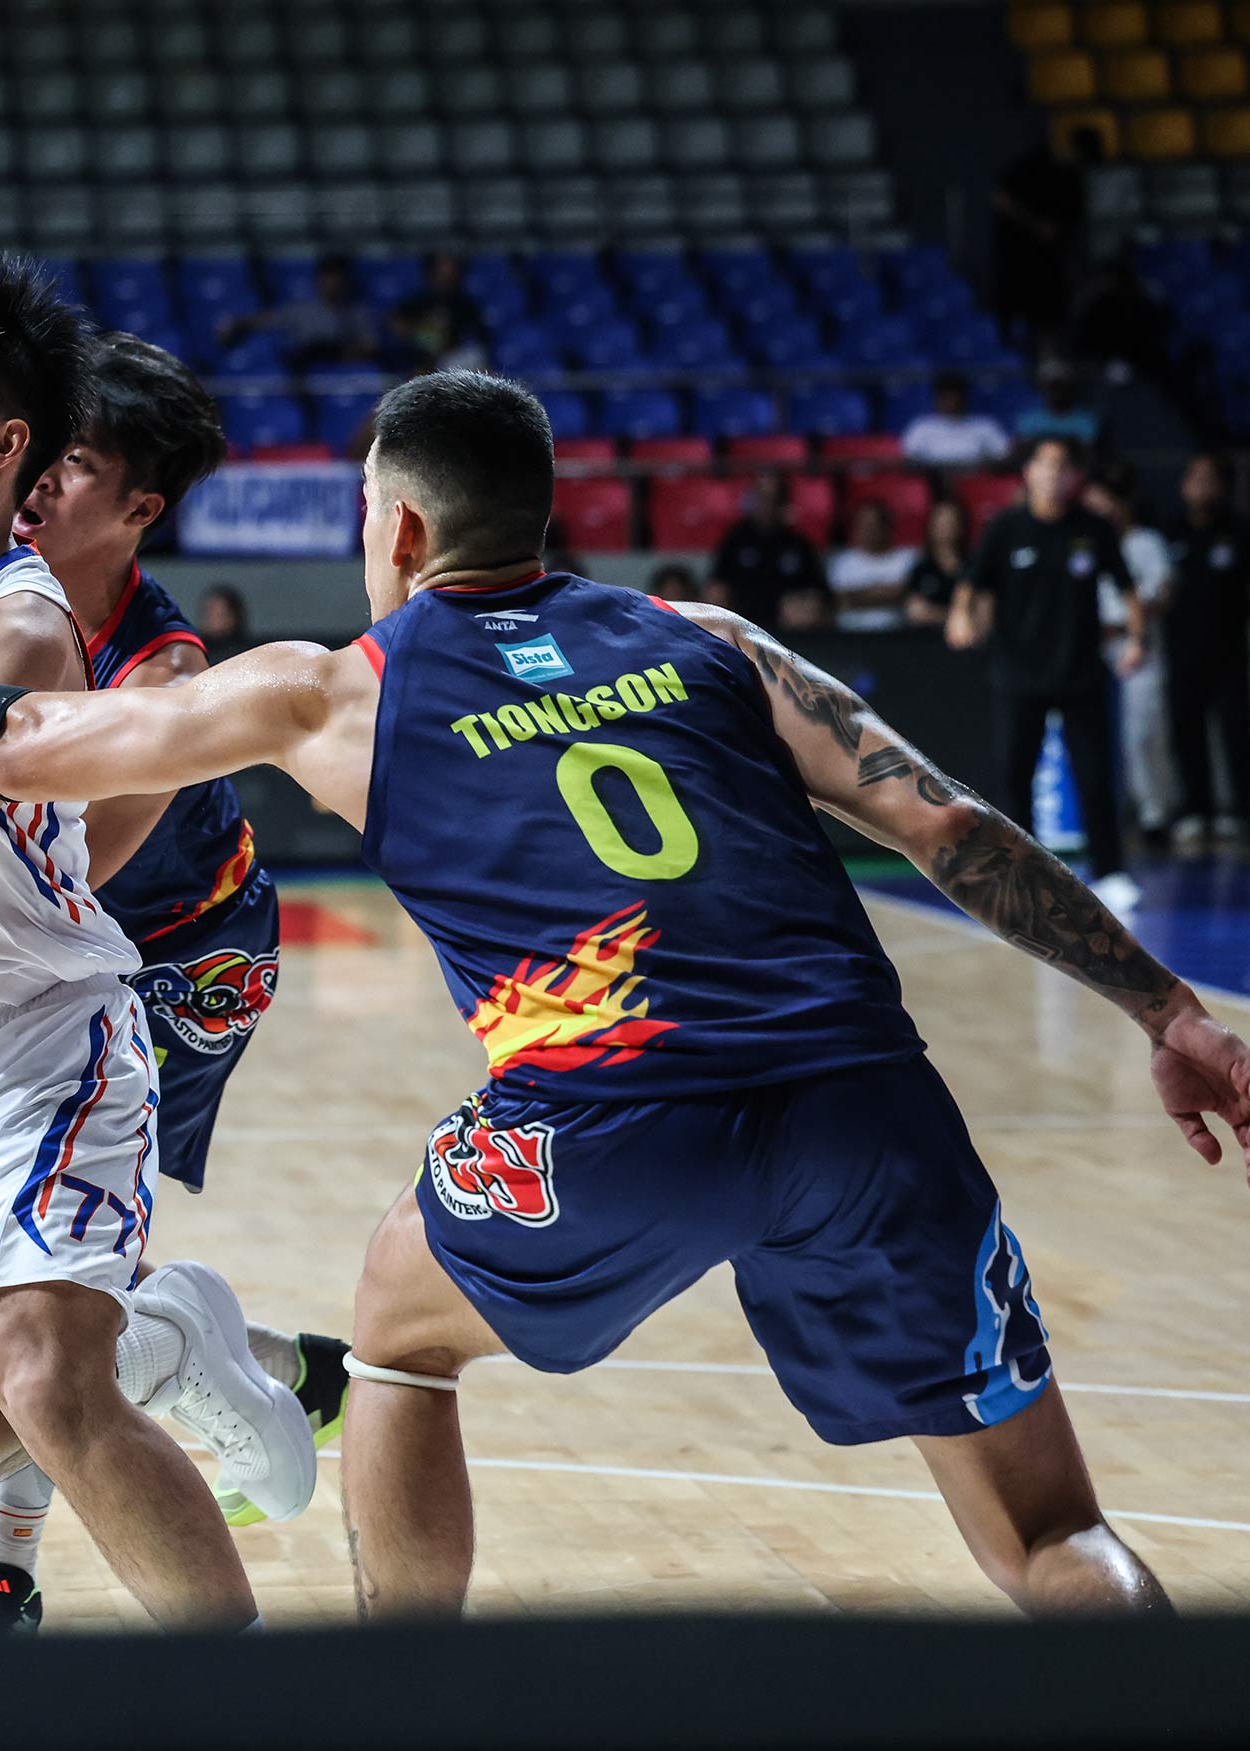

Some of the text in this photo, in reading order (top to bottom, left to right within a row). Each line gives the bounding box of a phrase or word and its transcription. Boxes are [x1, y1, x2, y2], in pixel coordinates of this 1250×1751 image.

[485, 620, 518, 631] ANTA
[511, 652, 554, 665] Sista
[450, 662, 690, 760] TIONGSON
[555, 741, 699, 881] 0
[60, 1172, 138, 1258] 77
